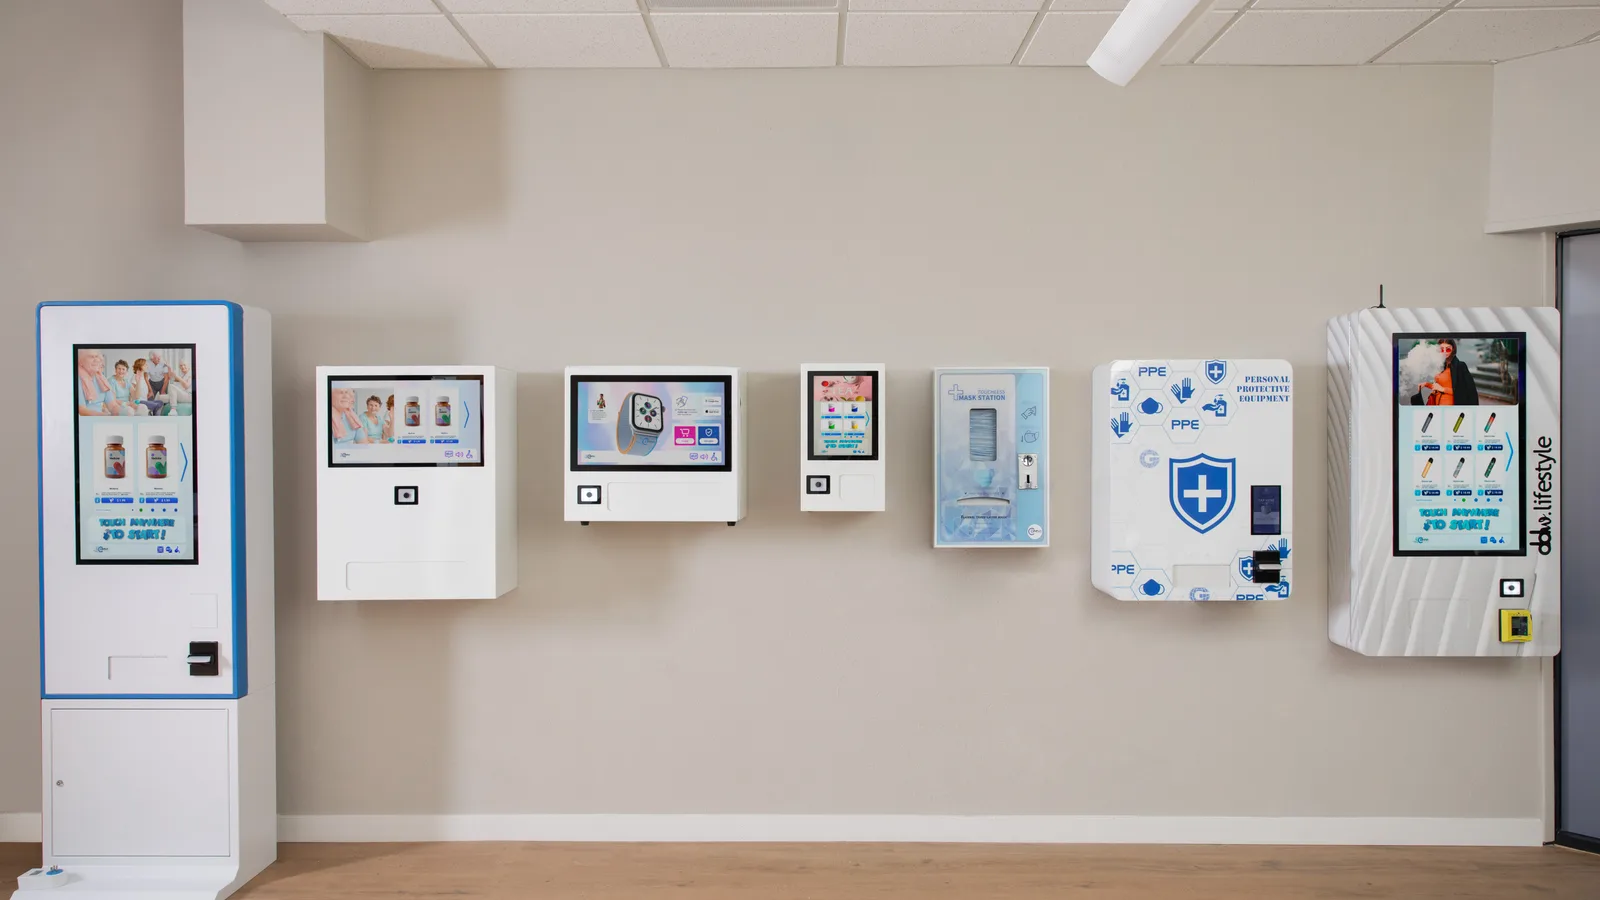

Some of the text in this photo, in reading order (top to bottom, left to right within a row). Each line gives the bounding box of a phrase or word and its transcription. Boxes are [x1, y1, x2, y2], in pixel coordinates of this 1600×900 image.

[1138, 366, 1167, 377] PPE
[1236, 385, 1290, 393] PROTECTIVE
[1171, 419, 1200, 430] PPE
[1419, 508, 1448, 517] TOUCH
[99, 518, 126, 527] TOUCH
[1431, 519, 1446, 530] TO
[110, 529, 125, 540] TO
